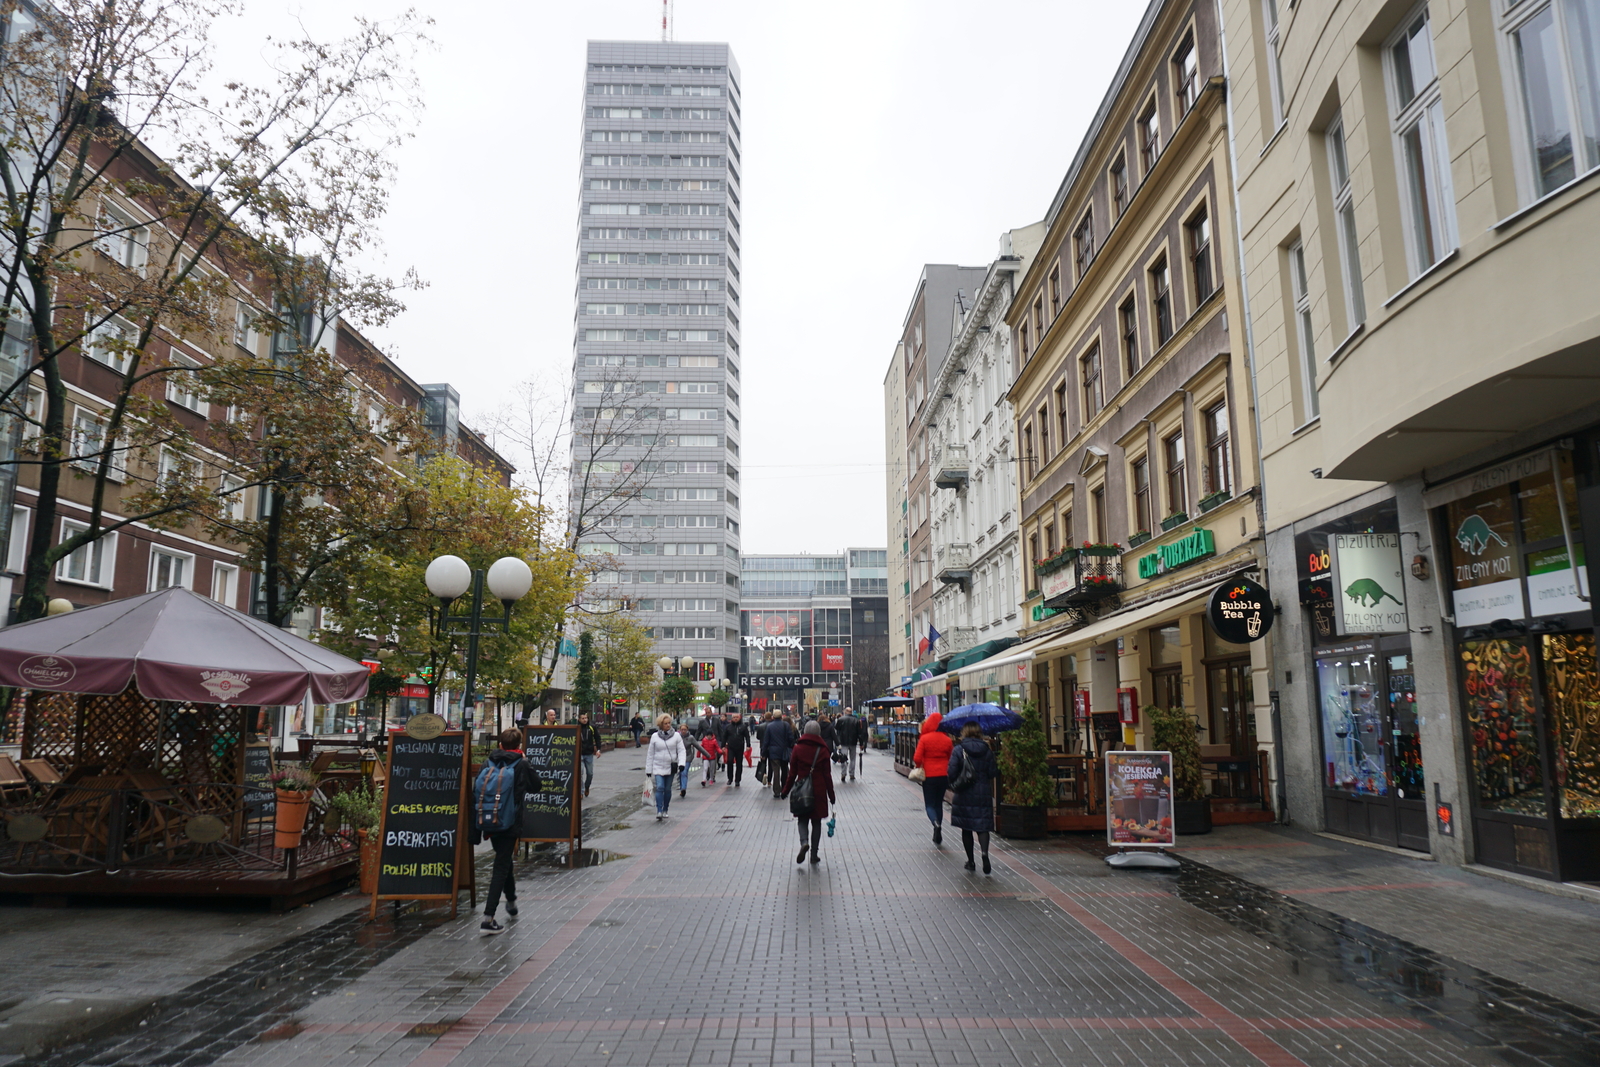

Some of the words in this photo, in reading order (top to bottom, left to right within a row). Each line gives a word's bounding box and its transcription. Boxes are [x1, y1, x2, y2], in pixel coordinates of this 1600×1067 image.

[1516, 456, 1537, 476] KOT
[1456, 560, 1491, 582] ZIELONY
[1493, 555, 1511, 574] KOT
[1220, 601, 1261, 610] Bubble
[1223, 610, 1244, 619] Tea
[1344, 613, 1383, 625] ZIELONY
[1387, 612, 1406, 624] KOT
[23, 667, 50, 676] CHMIEL
[50, 670, 69, 678] CAFE
[741, 677, 810, 686] RESERVED
[529, 735, 547, 745] HOT
[395, 742, 436, 754] BELGIAN
[438, 743, 464, 756] BEERS
[550, 748, 573, 757] PIWO
[392, 765, 412, 777] HOT
[420, 767, 460, 779] BELGIAN
[1118, 765, 1162, 775] KOLEKCJA
[404, 780, 459, 791] CHOCOLATE
[524, 792, 547, 803] APPLE
[390, 804, 423, 815] CAKES
[431, 804, 458, 815] COFFEE
[386, 829, 456, 848] BREAKFAST
[383, 863, 418, 877] POLISH
[421, 862, 452, 878] BEERS
